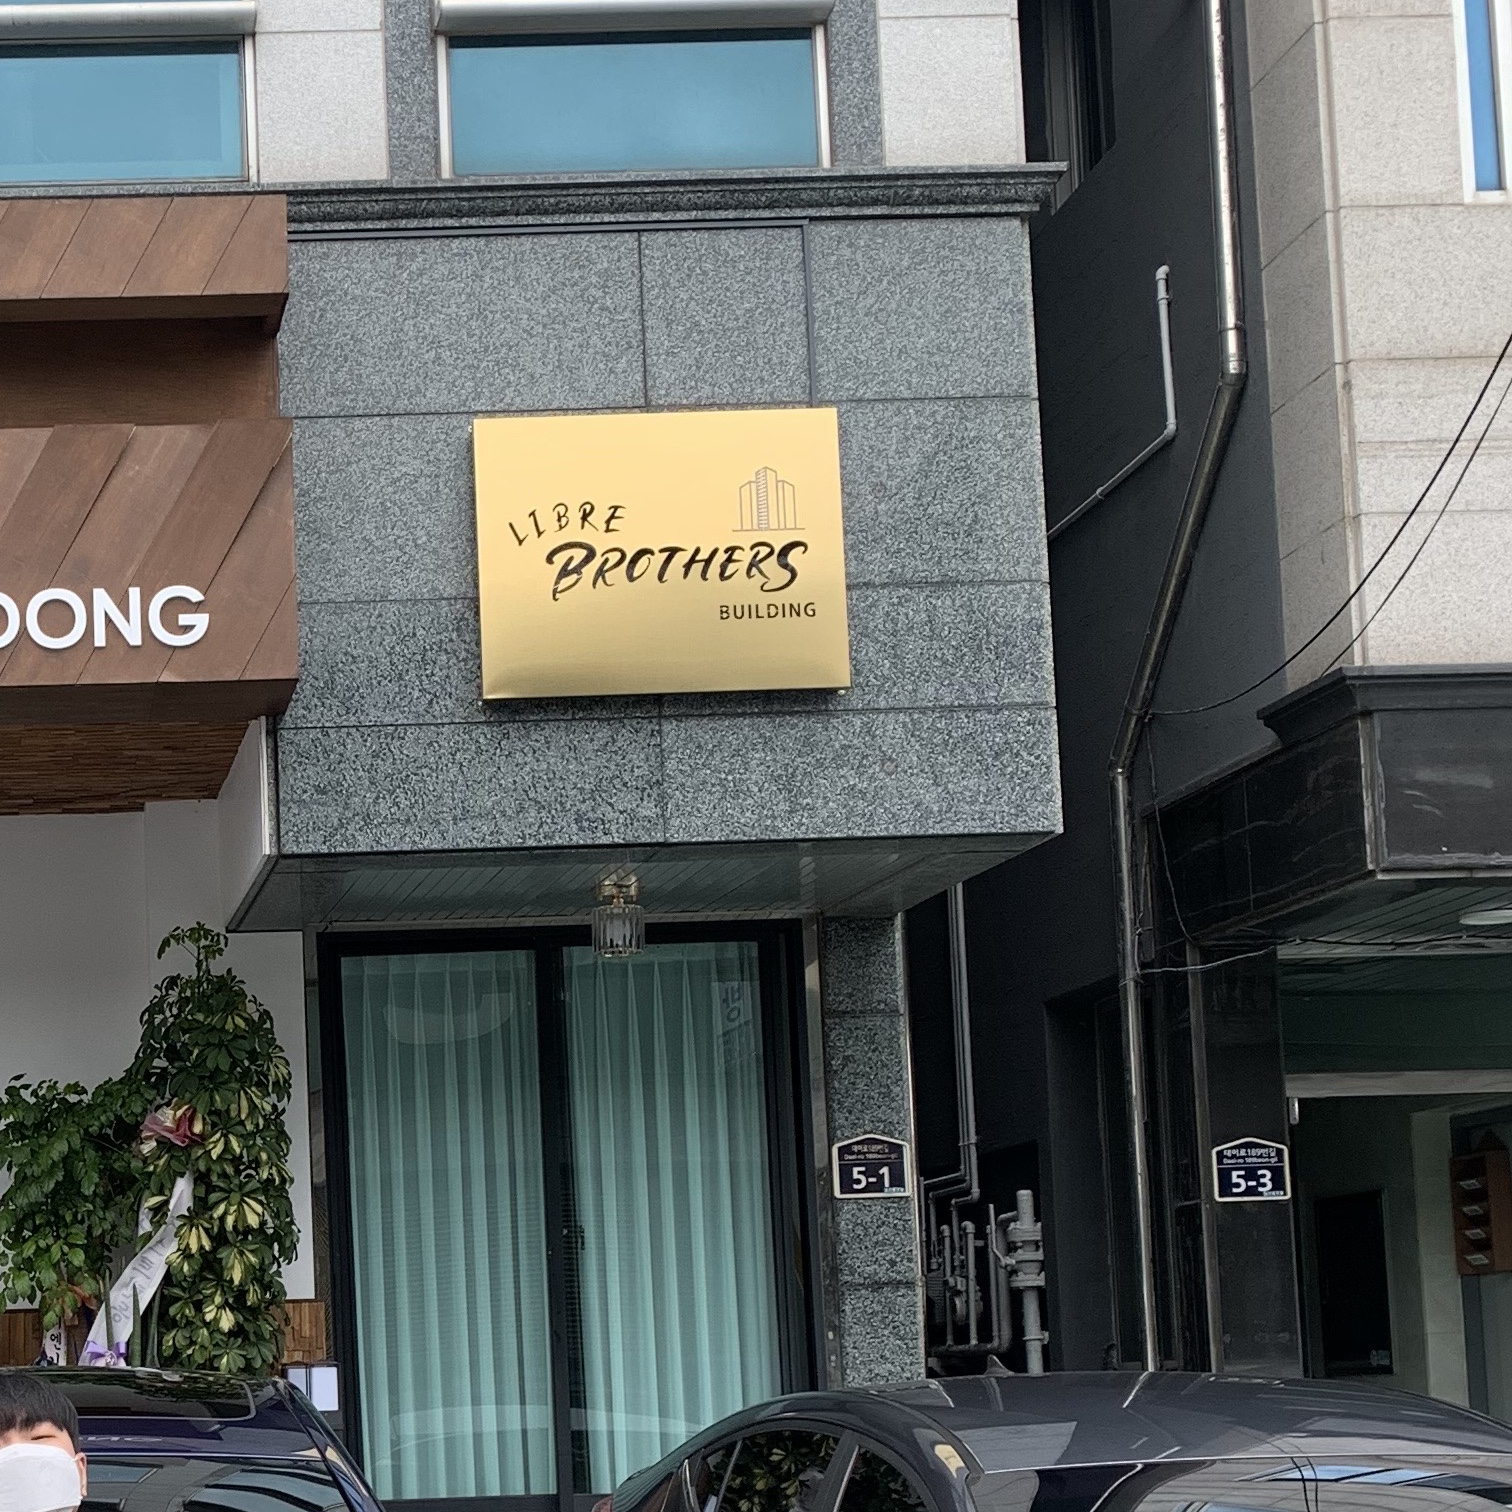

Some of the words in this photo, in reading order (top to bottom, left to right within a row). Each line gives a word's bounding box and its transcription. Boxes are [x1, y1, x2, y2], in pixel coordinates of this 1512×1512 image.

[508, 501, 627, 546] LIBRE
[545, 540, 809, 601] BROTHERS
[719, 602, 817, 620] BUILDING
[852, 1165, 891, 1190] 5-1
[1231, 1169, 1273, 1193] 5-3
